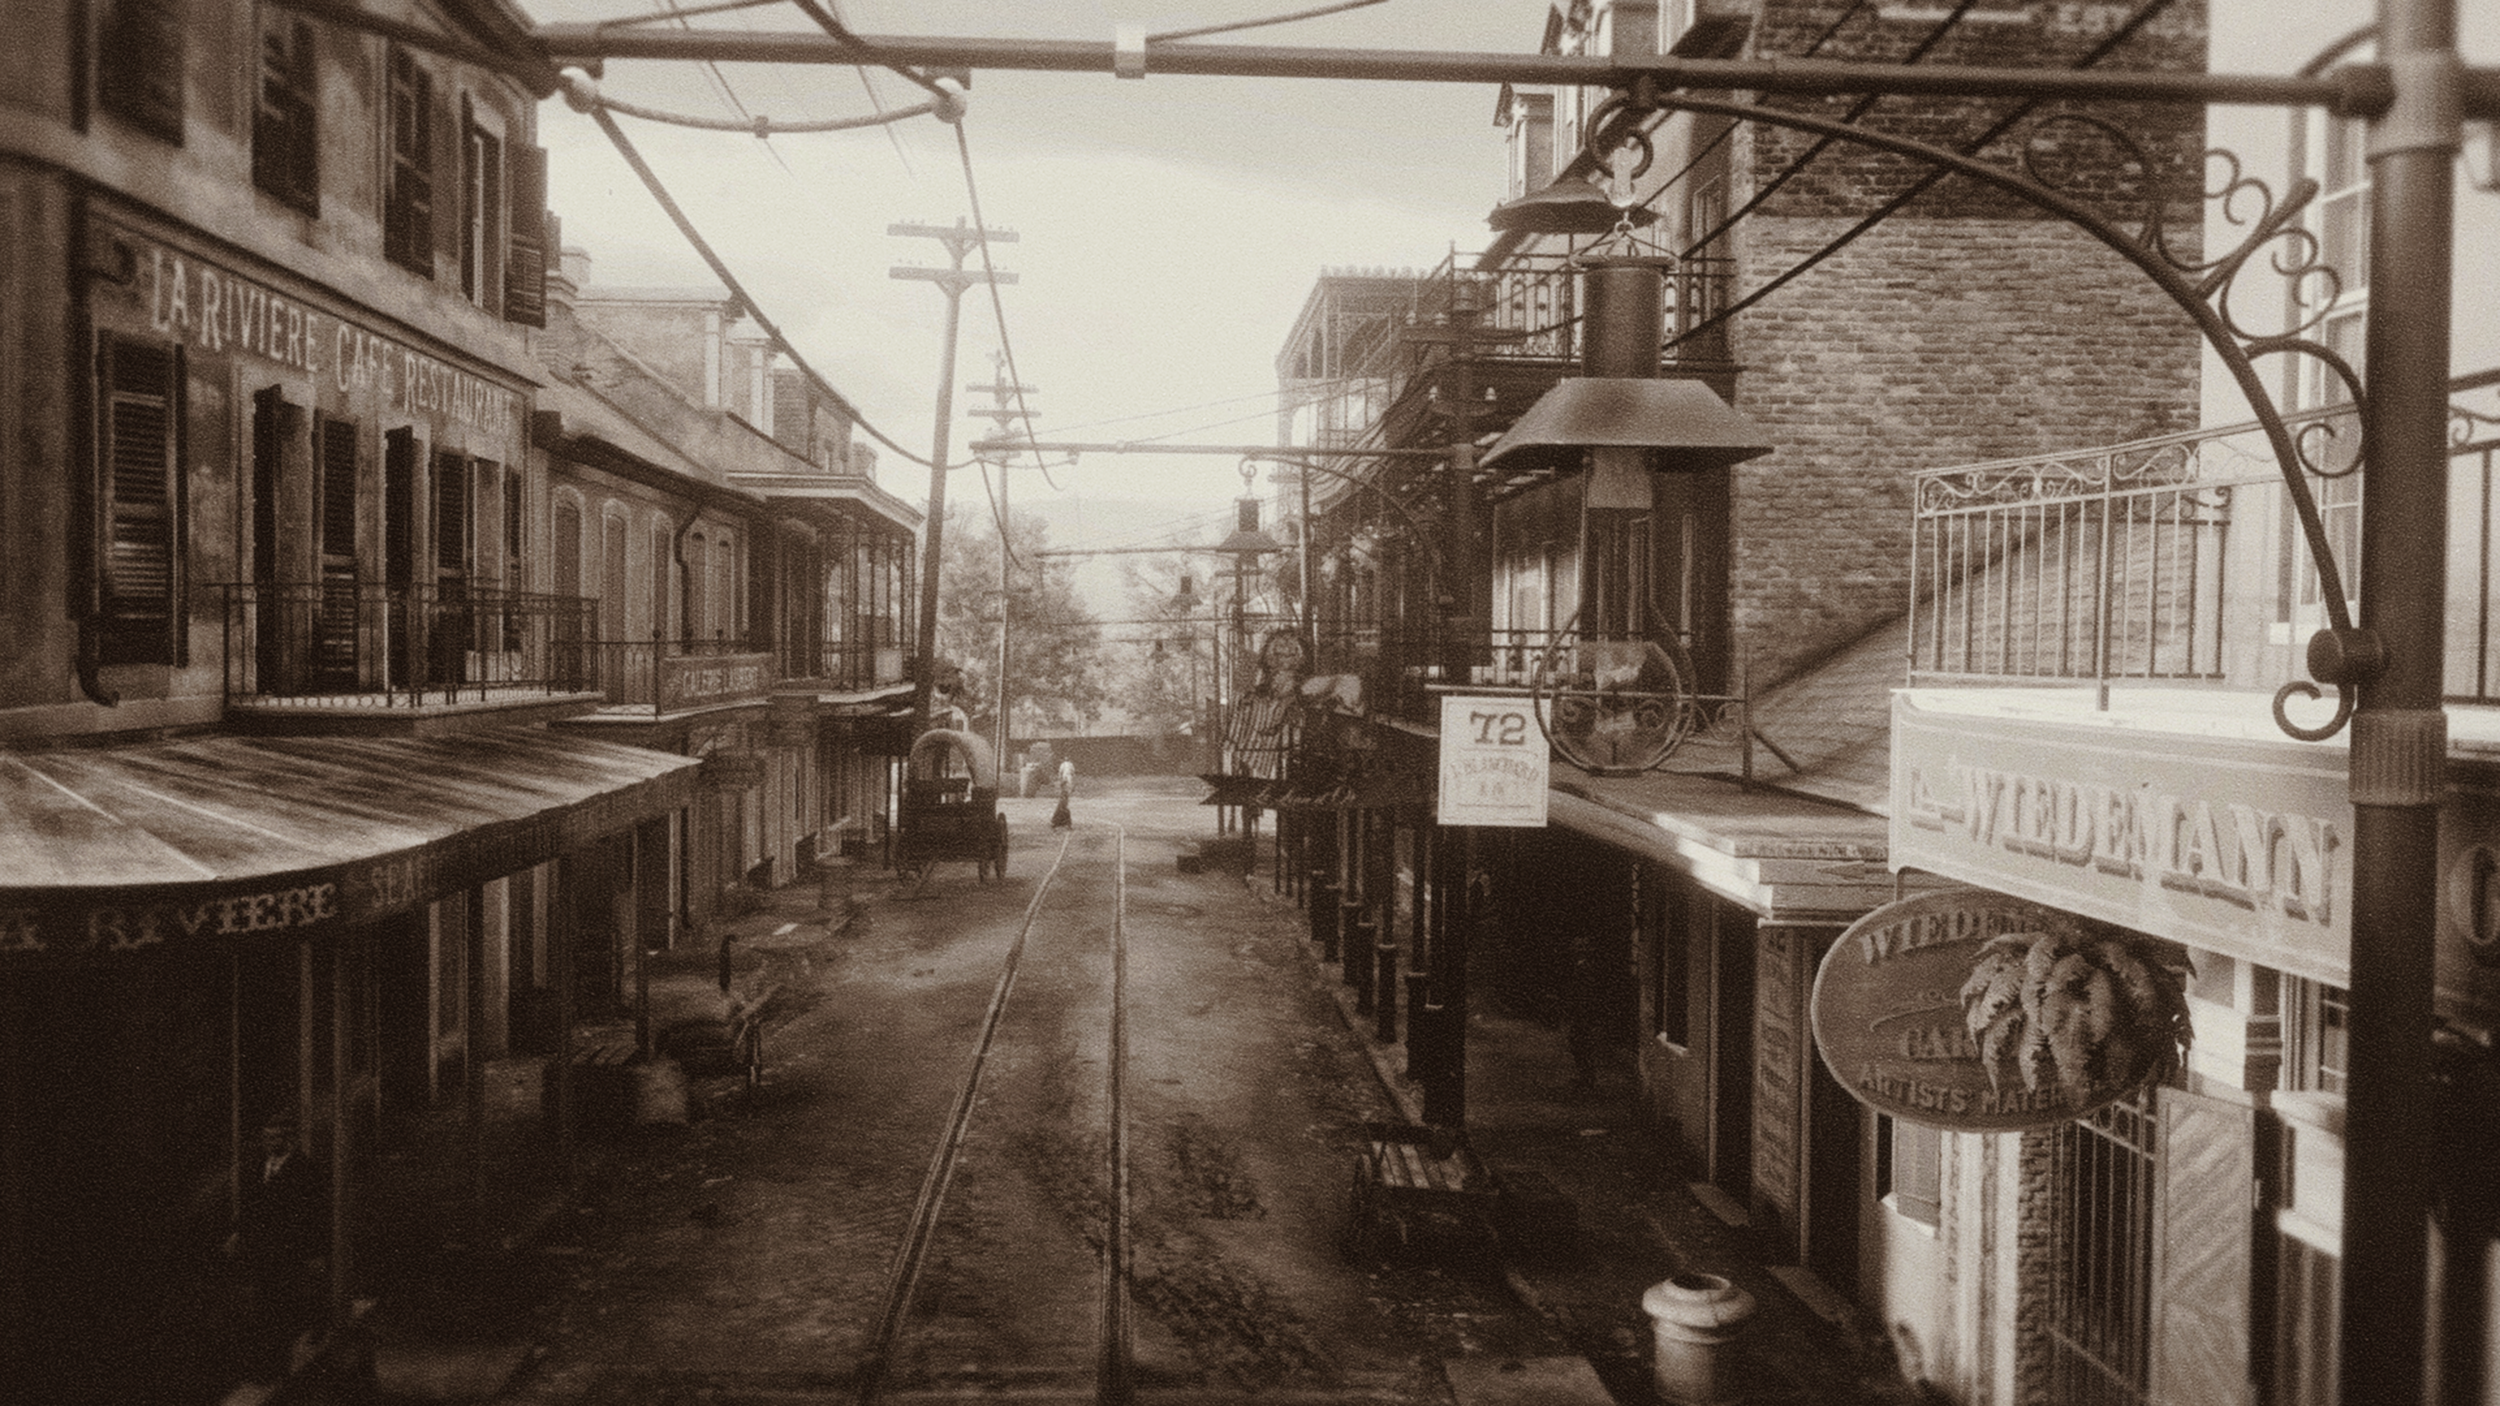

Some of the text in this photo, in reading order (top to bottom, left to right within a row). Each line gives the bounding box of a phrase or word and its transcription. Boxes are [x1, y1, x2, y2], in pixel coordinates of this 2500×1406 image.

[152, 248, 189, 333] LA
[201, 268, 319, 373] RIVIERE
[1470, 709, 1526, 745] 72
